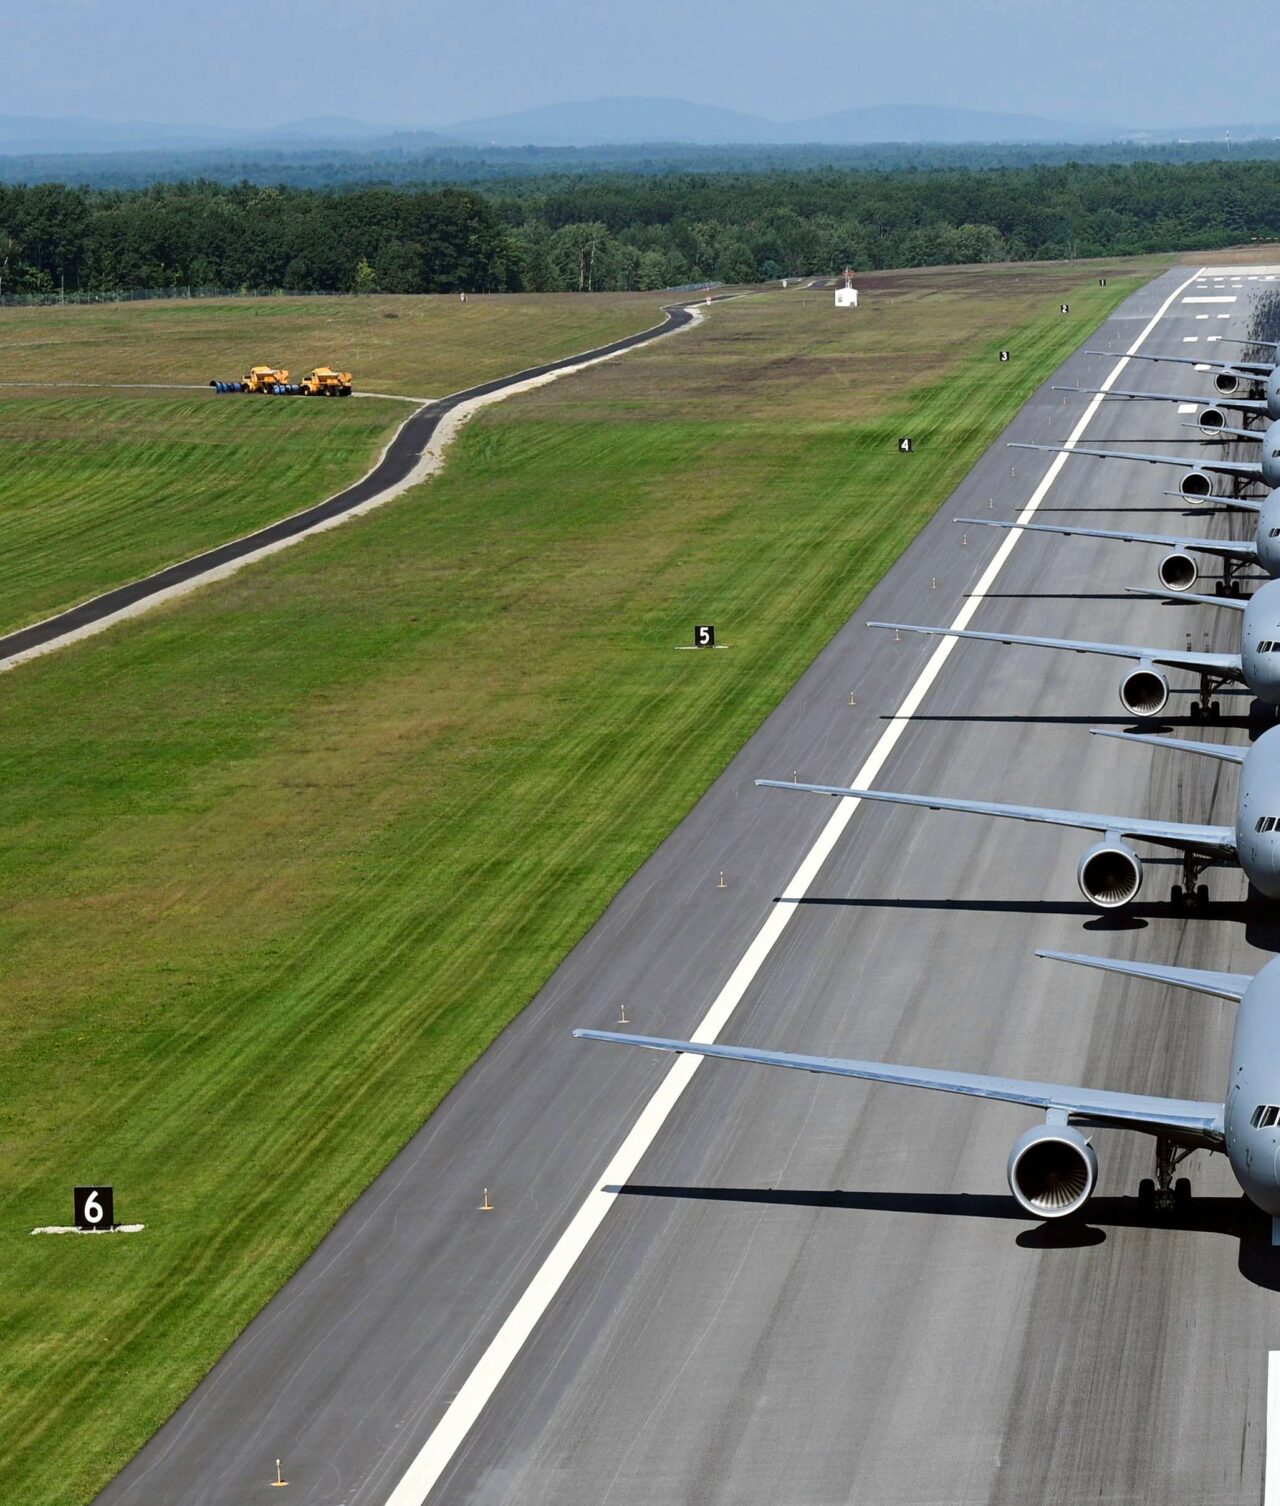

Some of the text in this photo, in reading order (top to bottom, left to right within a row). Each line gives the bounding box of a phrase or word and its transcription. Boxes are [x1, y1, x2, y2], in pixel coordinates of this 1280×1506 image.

[1002, 351, 1007, 361] 3
[901, 438, 909, 452] 4
[700, 627, 710, 644] 5
[84, 1190, 104, 1224] 6
